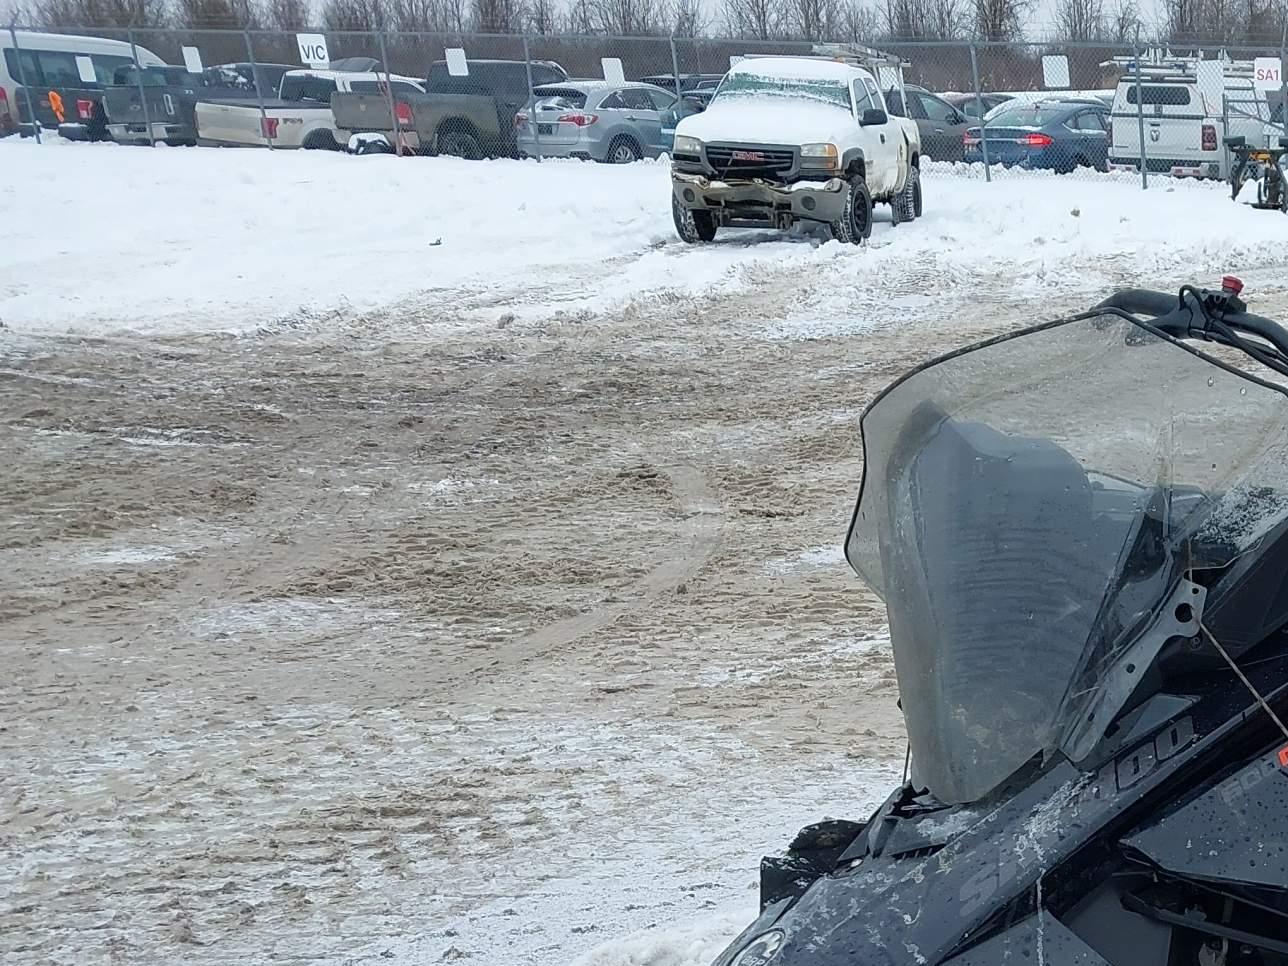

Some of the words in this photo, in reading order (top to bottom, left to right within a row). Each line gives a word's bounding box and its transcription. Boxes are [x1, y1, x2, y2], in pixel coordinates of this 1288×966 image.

[301, 44, 326, 61] VIC
[1256, 68, 1279, 81] SA1
[732, 150, 765, 162] GMC
